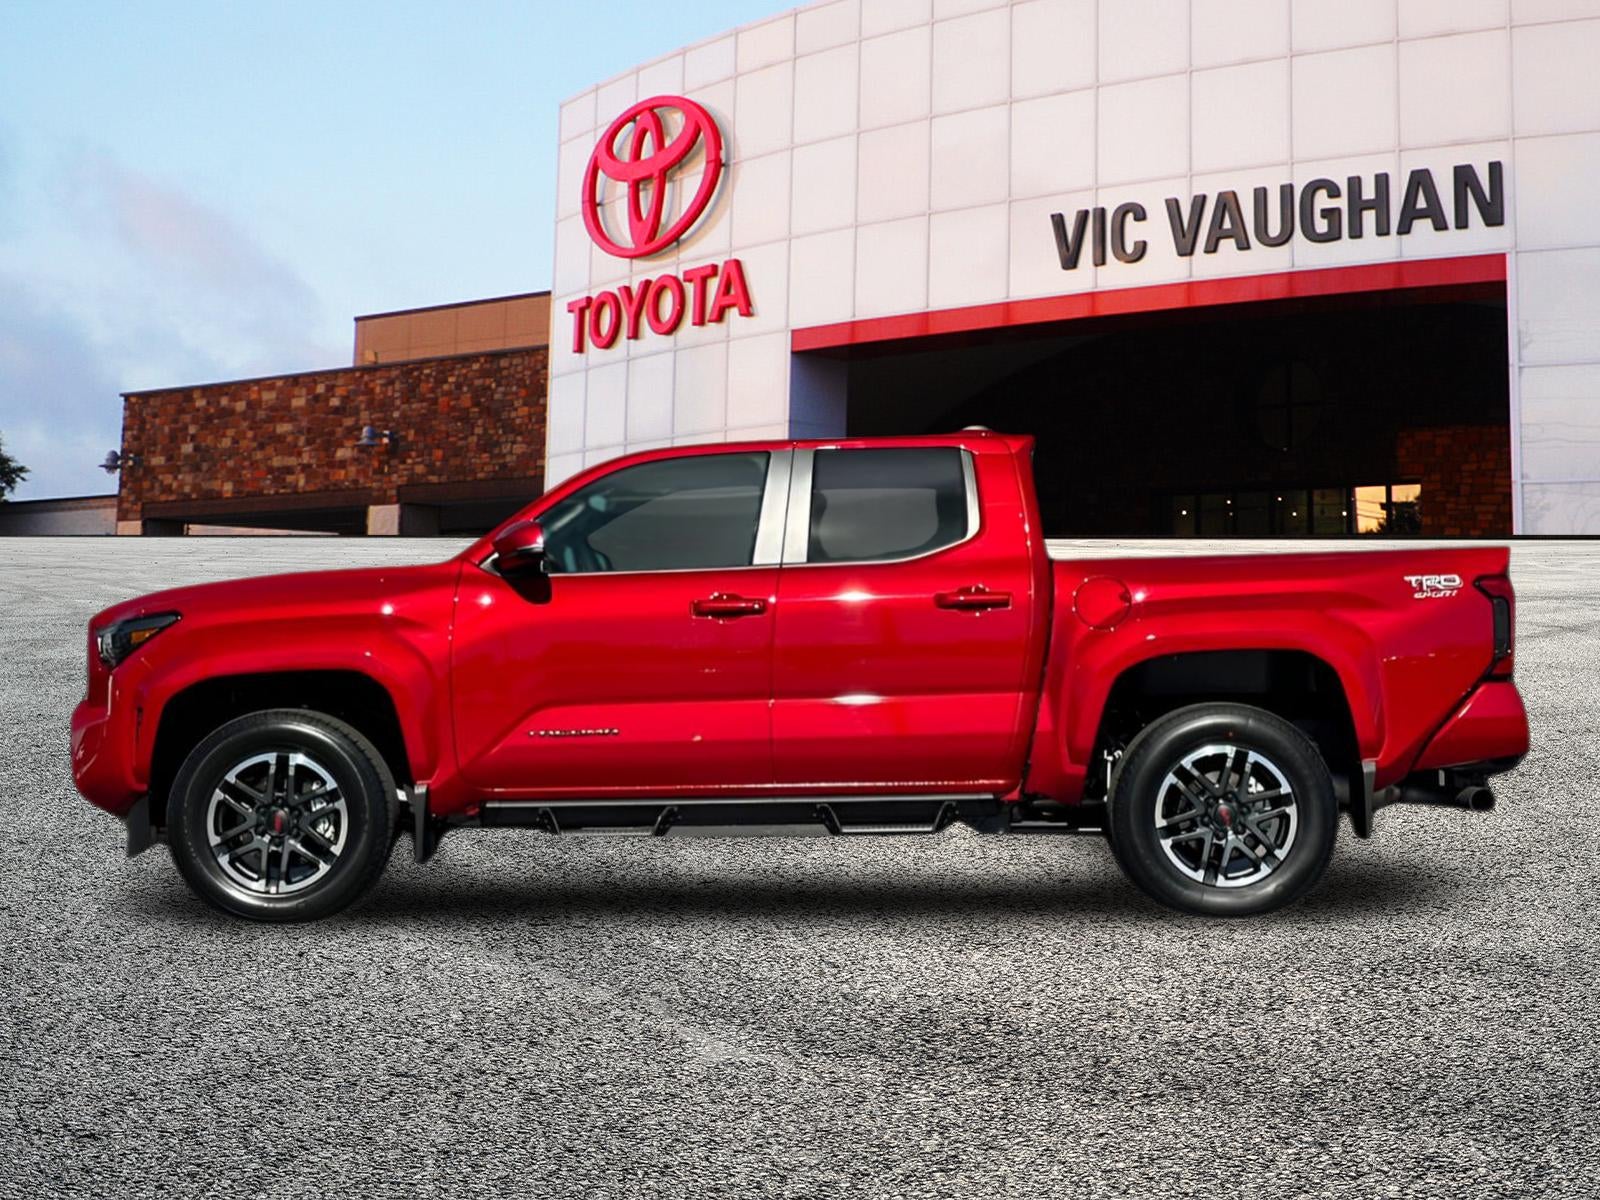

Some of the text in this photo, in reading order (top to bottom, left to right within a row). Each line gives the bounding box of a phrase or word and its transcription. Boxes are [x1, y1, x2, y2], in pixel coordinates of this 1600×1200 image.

[1051, 160, 1505, 270] VIC VAUGHAN
[567, 258, 754, 353] TOYOTA
[1403, 574, 1464, 590] TRD
